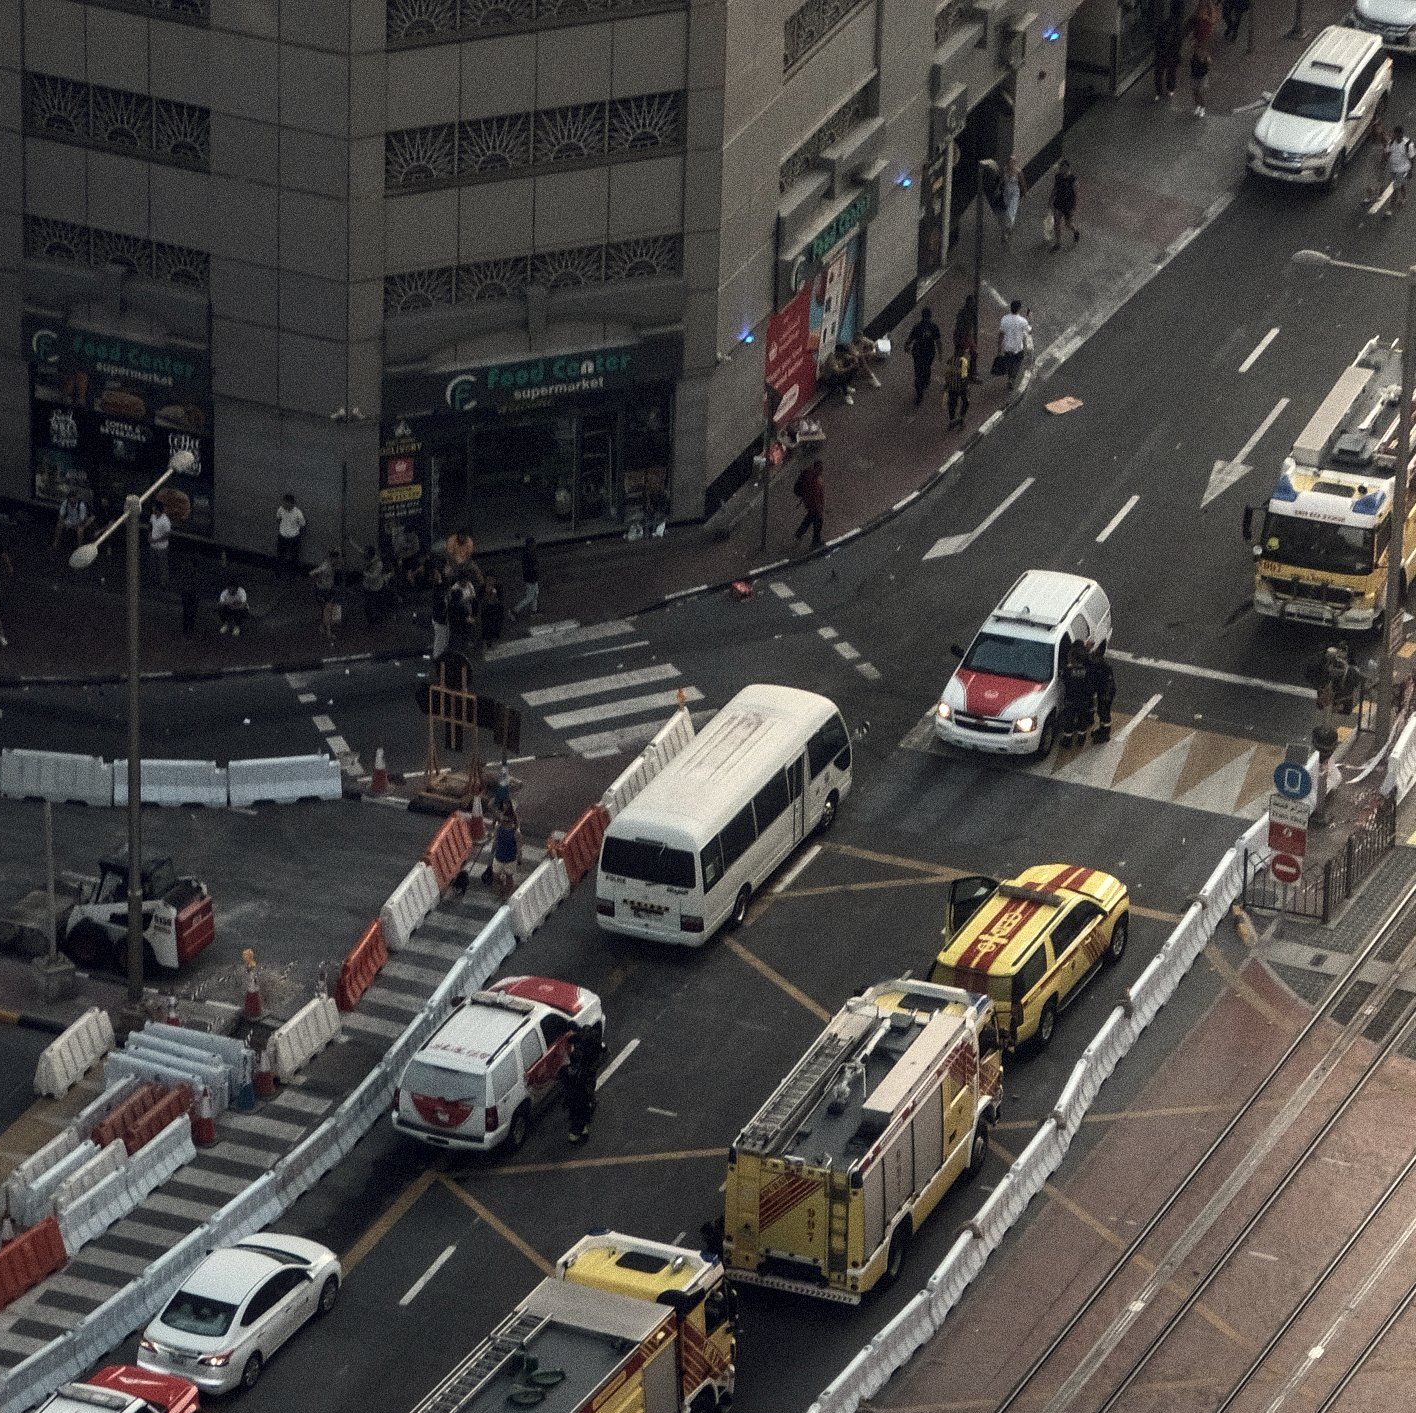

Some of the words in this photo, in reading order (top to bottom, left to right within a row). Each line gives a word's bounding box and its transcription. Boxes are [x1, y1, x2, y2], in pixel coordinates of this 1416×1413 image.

[96, 362, 174, 387] supermarket
[553, 352, 632, 379] Center
[513, 376, 604, 401] supermarket
